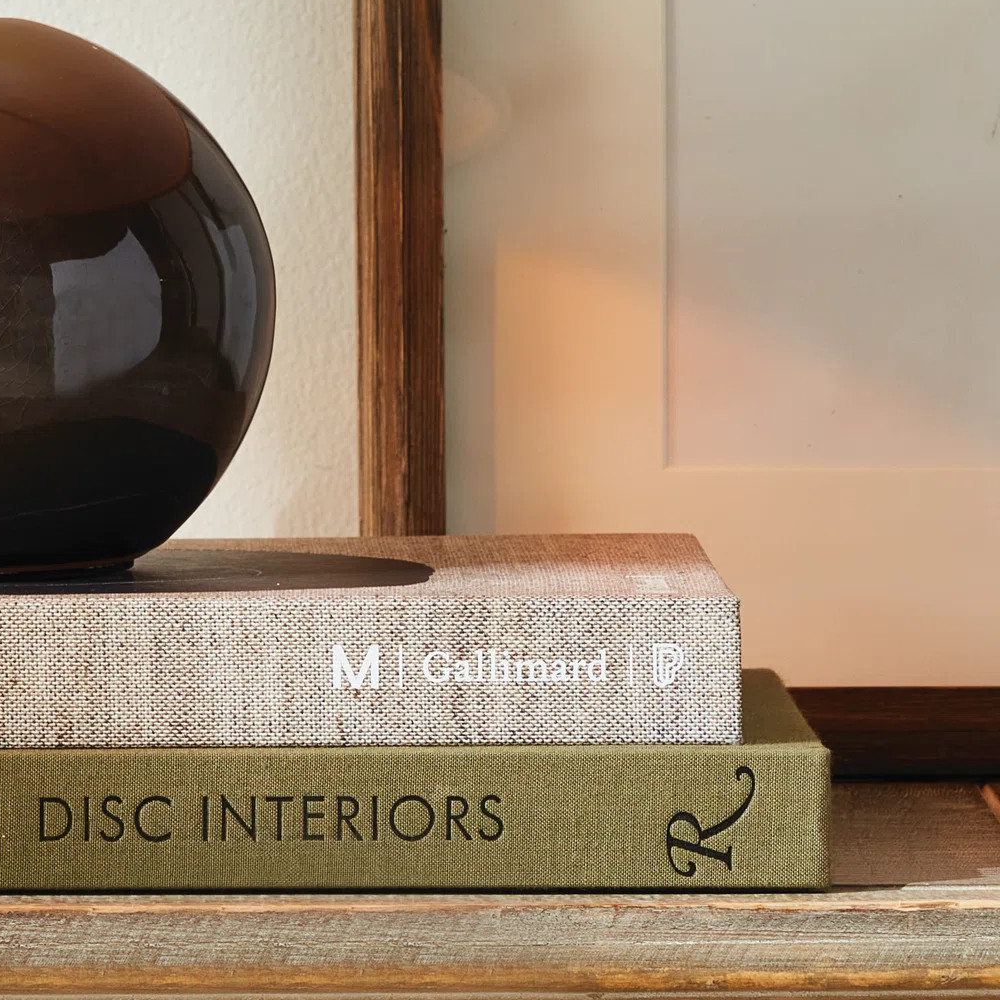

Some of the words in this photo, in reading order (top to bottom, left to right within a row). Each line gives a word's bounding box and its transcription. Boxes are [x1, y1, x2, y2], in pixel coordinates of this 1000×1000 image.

[332, 643, 380, 689] M
[422, 648, 608, 683] Gallimard
[38, 794, 173, 843] DISC
[200, 794, 505, 842] INTERIORS
[667, 766, 756, 877] R
